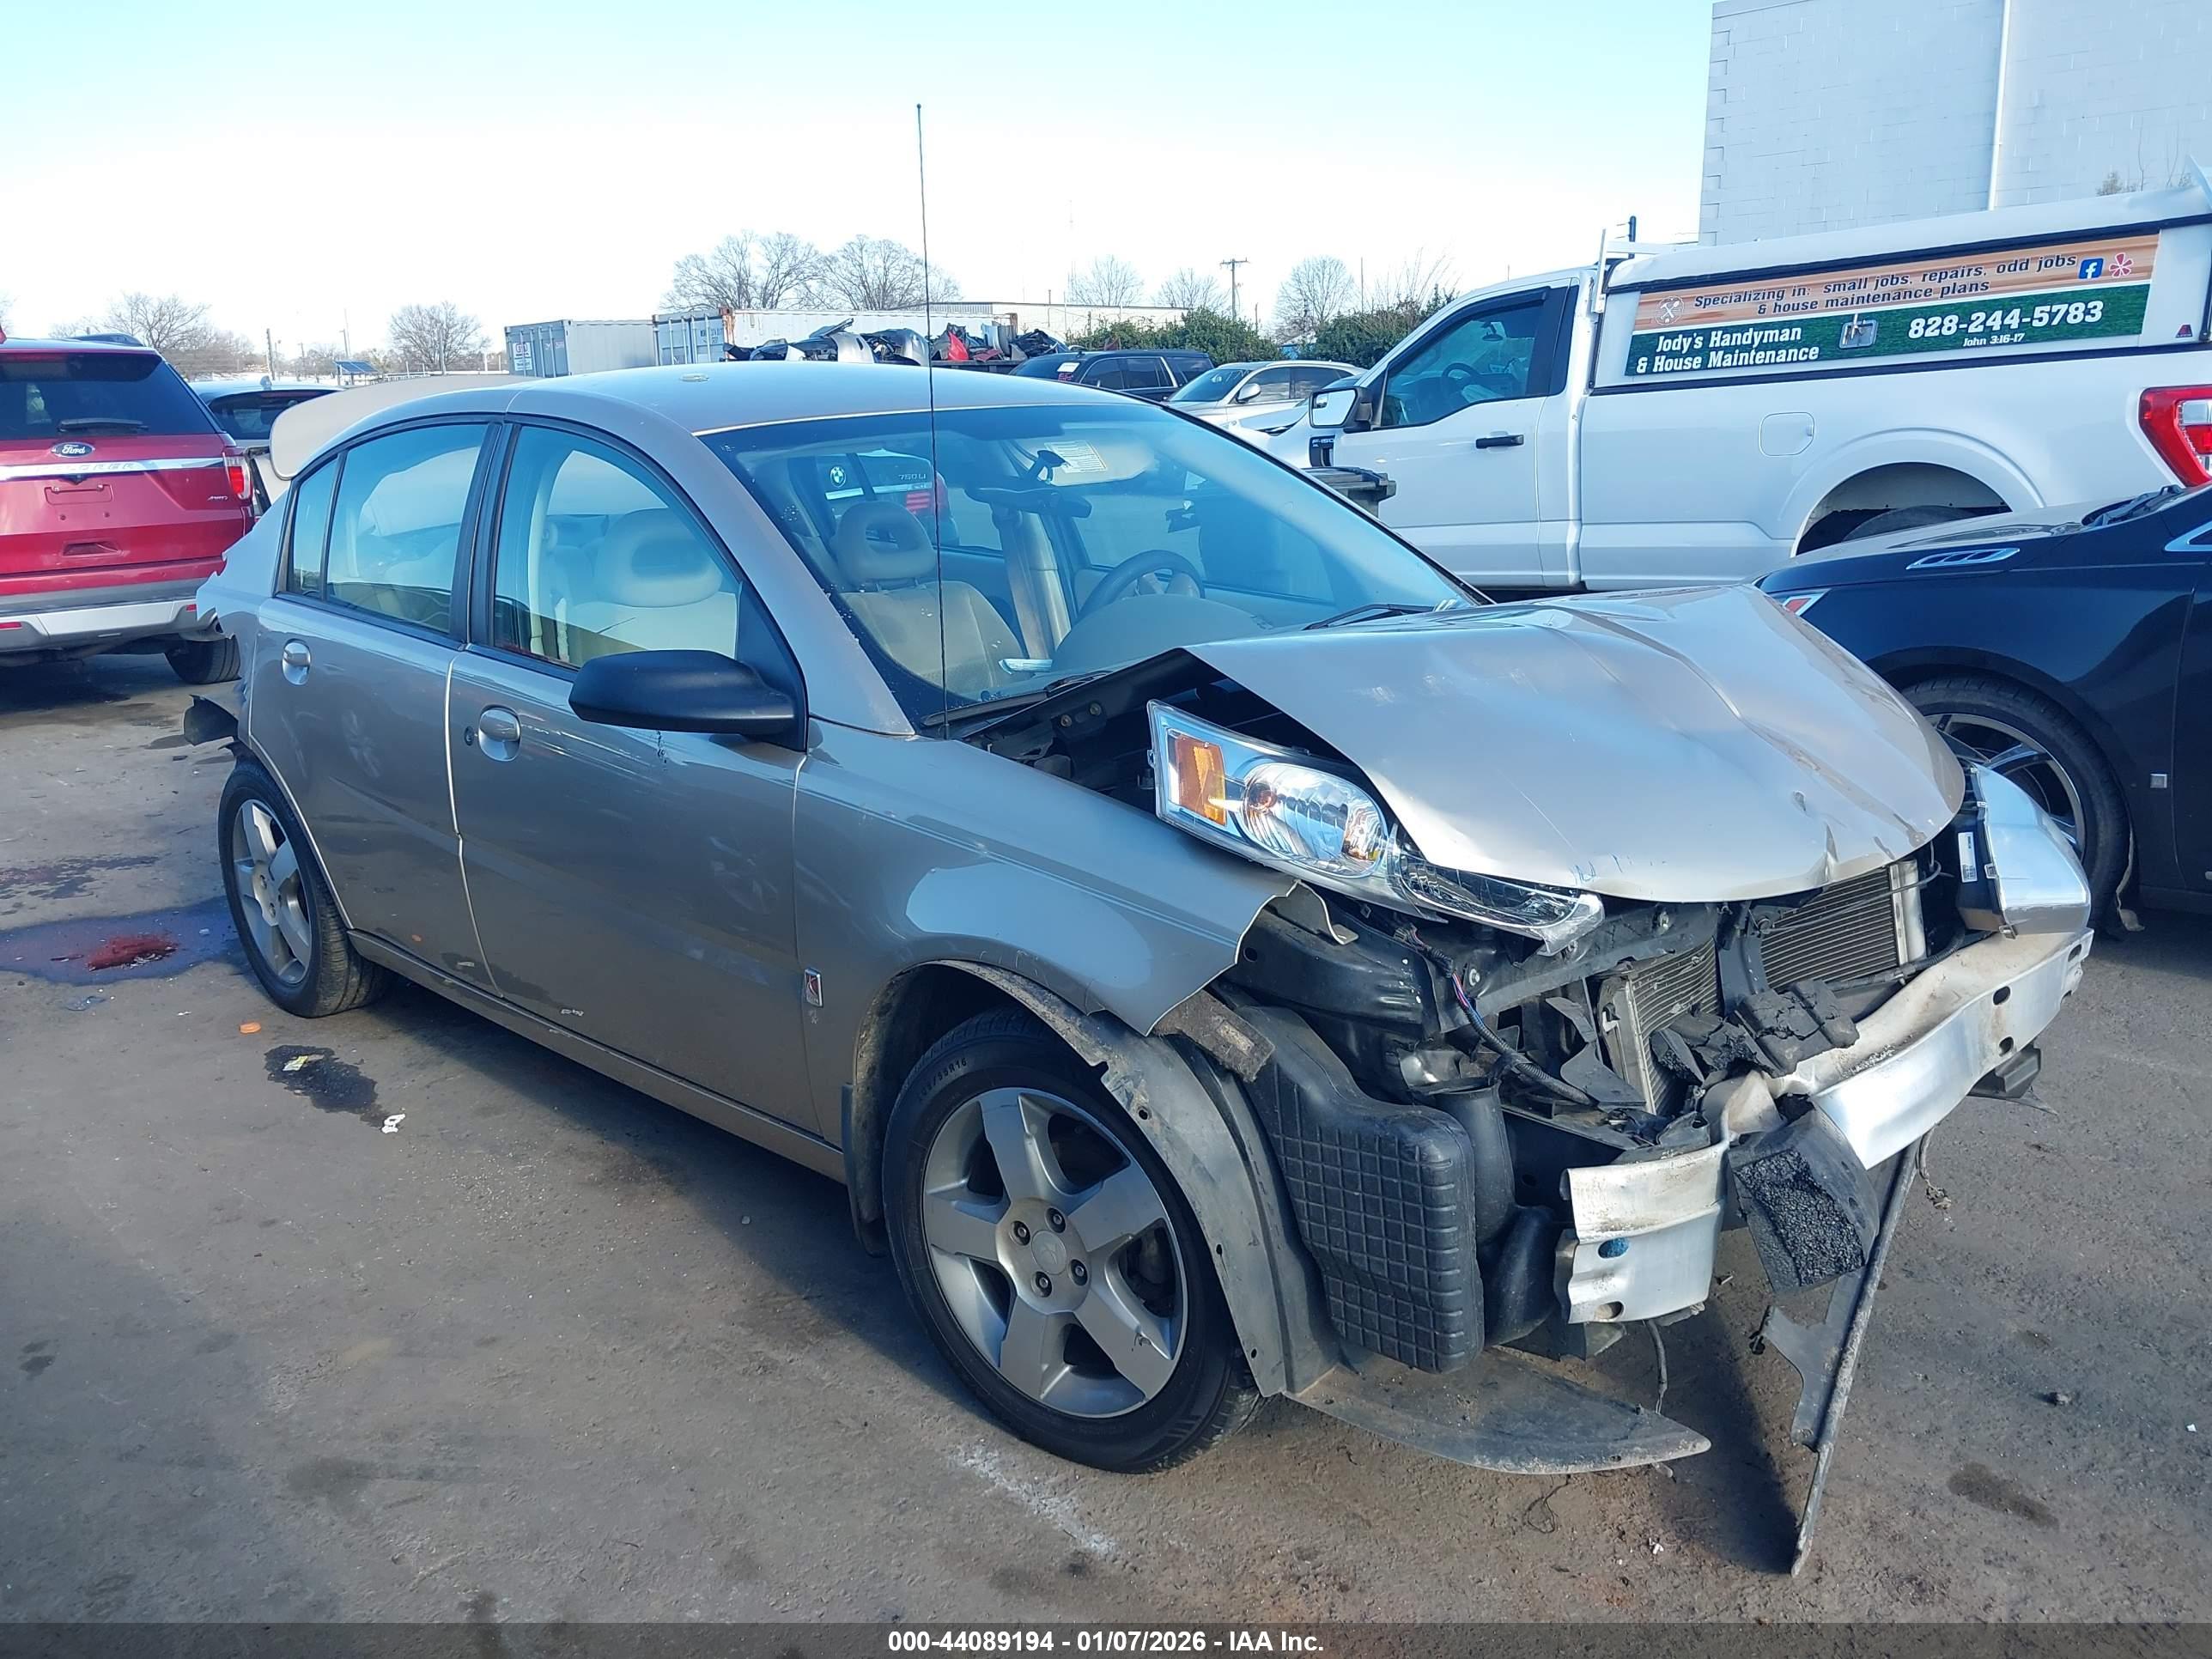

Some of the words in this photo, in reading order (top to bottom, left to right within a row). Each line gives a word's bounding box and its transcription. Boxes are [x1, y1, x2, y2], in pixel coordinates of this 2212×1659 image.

[1694, 290, 1785, 309] Specializing
[1791, 285, 1811, 298] in:
[1823, 277, 1868, 294] small
[1996, 258, 2029, 274] odd
[2036, 254, 2076, 273] jobs
[1758, 304, 1767, 315] &
[1772, 299, 1818, 314] house
[1825, 289, 1933, 309] maintenance
[1939, 281, 1990, 300] plans
[1908, 301, 2105, 339] 828-244-5783
[1656, 332, 1703, 354] Jody's
[1709, 326, 1802, 348] Handyman
[1963, 336, 1986, 347] John
[1990, 332, 2025, 344] 3:16-17
[1636, 356, 1648, 374] &
[1652, 353, 1701, 373] House
[1707, 345, 1820, 369] Maintenance
[61, 444, 86, 455] Ford
